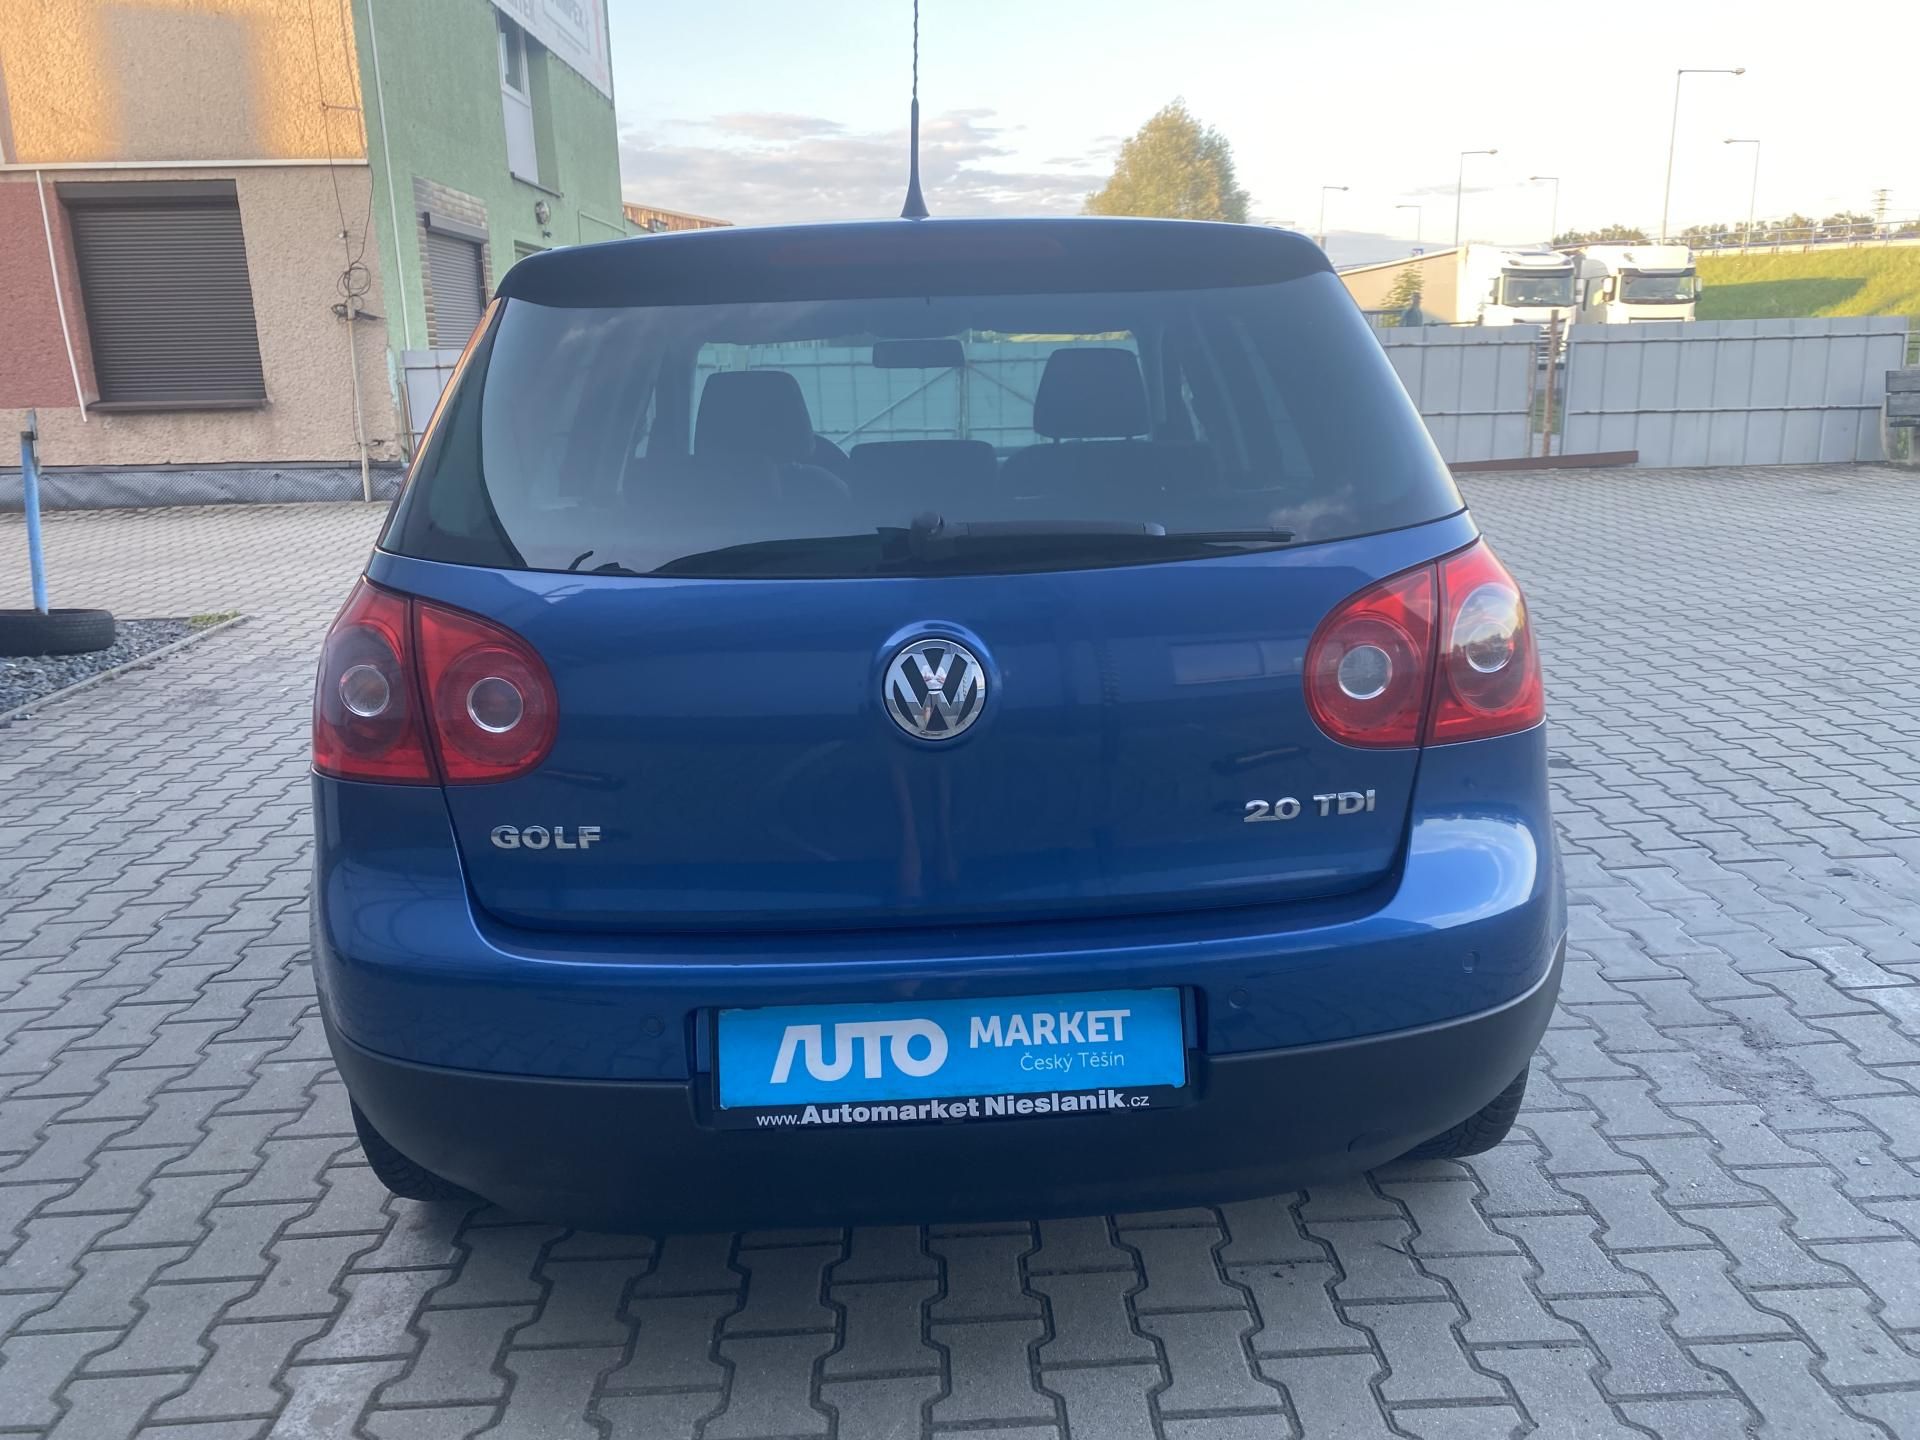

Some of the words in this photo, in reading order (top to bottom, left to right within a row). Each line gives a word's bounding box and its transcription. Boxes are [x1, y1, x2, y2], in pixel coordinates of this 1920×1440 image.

[1313, 789, 1376, 817] TDI
[490, 825, 601, 850] GOLF
[770, 1018, 949, 1084] AUTO
[970, 1009, 1131, 1049] MARKET
[1020, 1052, 1073, 1073] Český
[1077, 1051, 1125, 1069] Těšín
